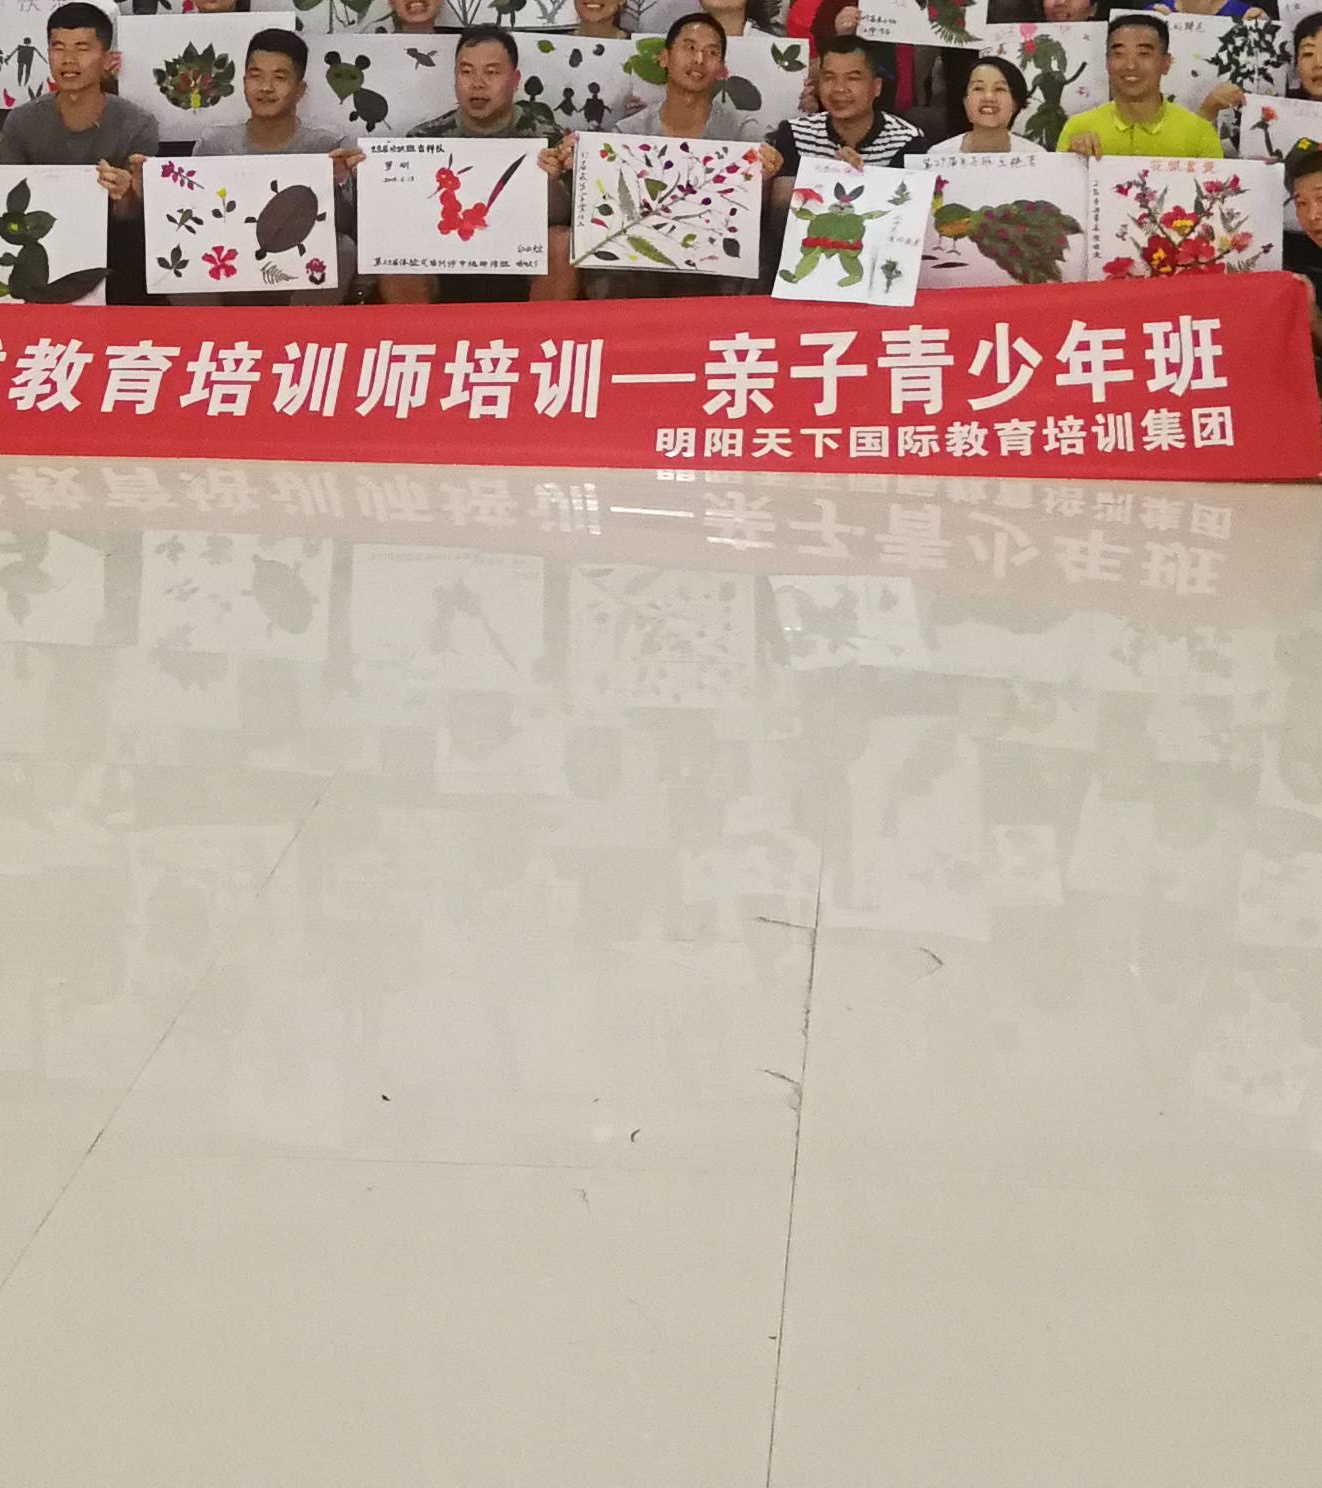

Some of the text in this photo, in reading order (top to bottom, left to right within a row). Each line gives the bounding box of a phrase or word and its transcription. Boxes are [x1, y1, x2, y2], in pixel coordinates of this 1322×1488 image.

[654, 406, 1235, 459] 明阳天下国际教育培训集团
